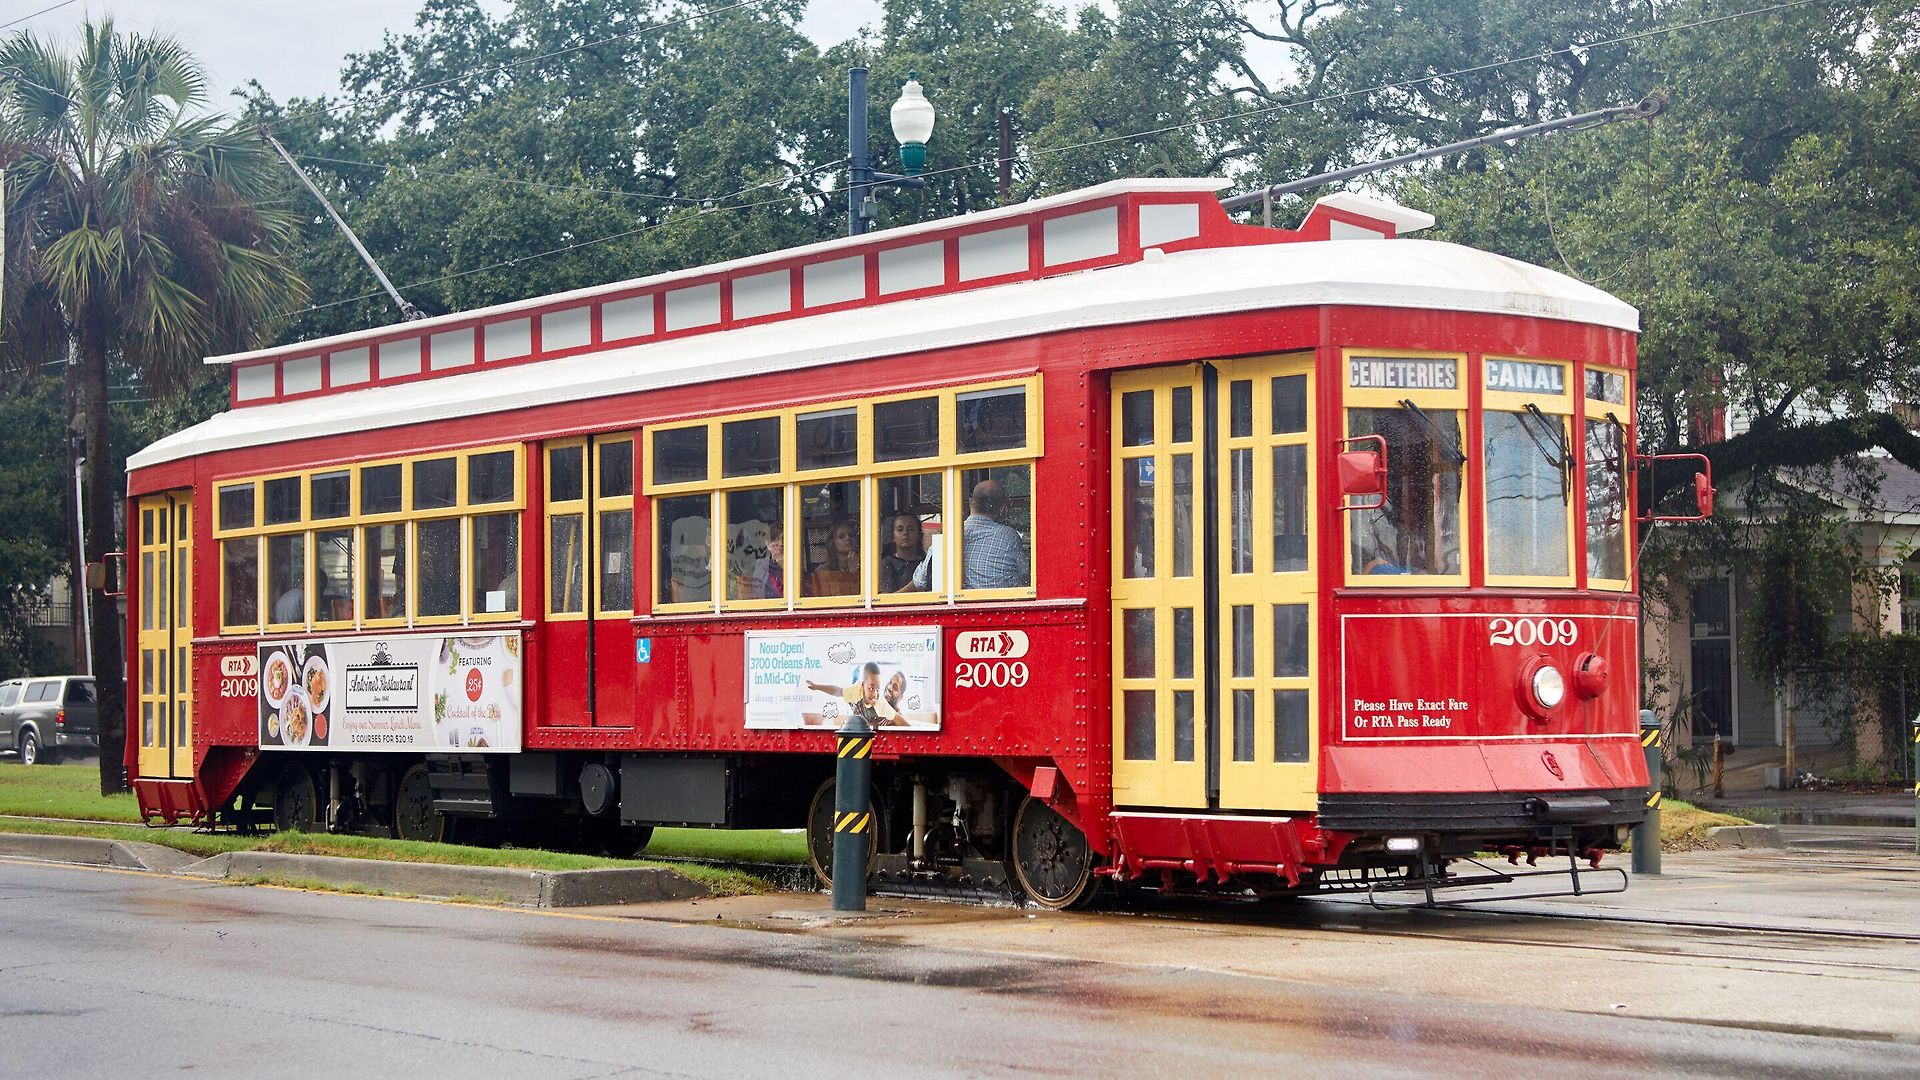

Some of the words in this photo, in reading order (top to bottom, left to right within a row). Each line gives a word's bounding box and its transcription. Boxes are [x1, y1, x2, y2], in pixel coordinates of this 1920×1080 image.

[1350, 361, 1456, 388] CEMETERIES
[1486, 359, 1563, 390] CANAL
[1489, 618, 1578, 646] 2009
[759, 642, 778, 654] Now
[780, 641, 805, 656] Open!
[970, 636, 996, 652] RTA
[228, 658, 242, 672] RTA
[458, 656, 492, 666] FEATURING
[750, 658, 770, 670] 3700
[772, 656, 803, 670] Orleans
[804, 656, 822, 669] Ave.
[754, 672, 762, 684] in
[764, 672, 800, 688] Mid-City
[955, 662, 1029, 688] 2009
[220, 678, 258, 698] 2009
[1354, 698, 1386, 712] Please
[1389, 698, 1414, 711] Have
[1417, 698, 1446, 711] Exact
[1448, 698, 1468, 710] Fare
[1354, 716, 1368, 728] Or
[1372, 716, 1394, 728] RTA
[1397, 716, 1419, 728] Pass
[1422, 716, 1452, 729] Ready
[352, 734, 355, 743] 3
[356, 734, 382, 743] COURSES
[382, 734, 394, 743] FOR
